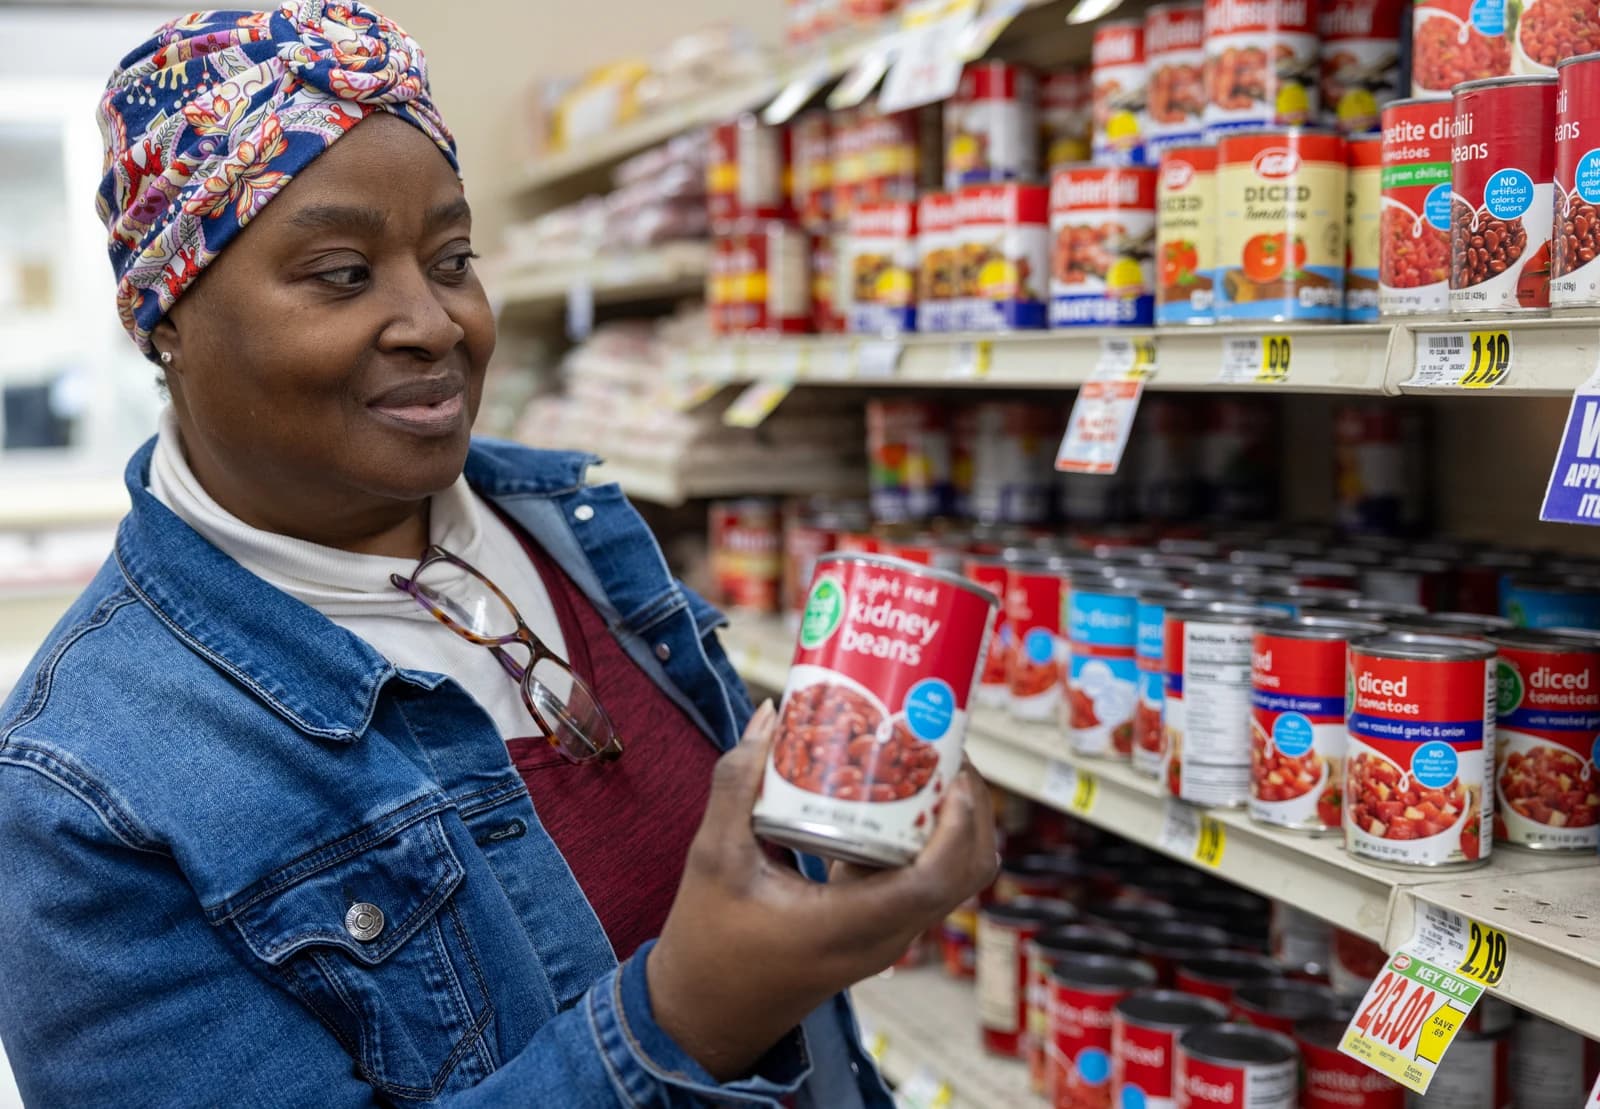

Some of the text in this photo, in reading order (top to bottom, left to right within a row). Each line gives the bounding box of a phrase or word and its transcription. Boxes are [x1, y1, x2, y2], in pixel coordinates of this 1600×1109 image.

[1491, 186, 1526, 195] artificial
[1500, 176, 1517, 186] NO
[1245, 185, 1311, 202] DICED
[1490, 195, 1515, 204] colors
[1495, 204, 1522, 213] flavors
[1462, 334, 1510, 385] 1.19
[905, 580, 939, 607] red
[848, 595, 940, 646] kidney
[840, 622, 923, 667] beans
[1358, 670, 1408, 698] diced
[1529, 665, 1590, 690] diced
[1357, 692, 1420, 715] tomatoes
[1405, 726, 1433, 739] garlic
[1433, 726, 1440, 737] &
[1441, 728, 1466, 737] onion
[1429, 749, 1444, 758] NO
[1460, 922, 1507, 984] 2.19
[1416, 965, 1442, 985] KEY
[1440, 976, 1470, 997] BUY
[1355, 971, 1436, 1051] 2/3.00
[1432, 1028, 1445, 1038] .69
[1433, 1016, 1455, 1032] SAVE
